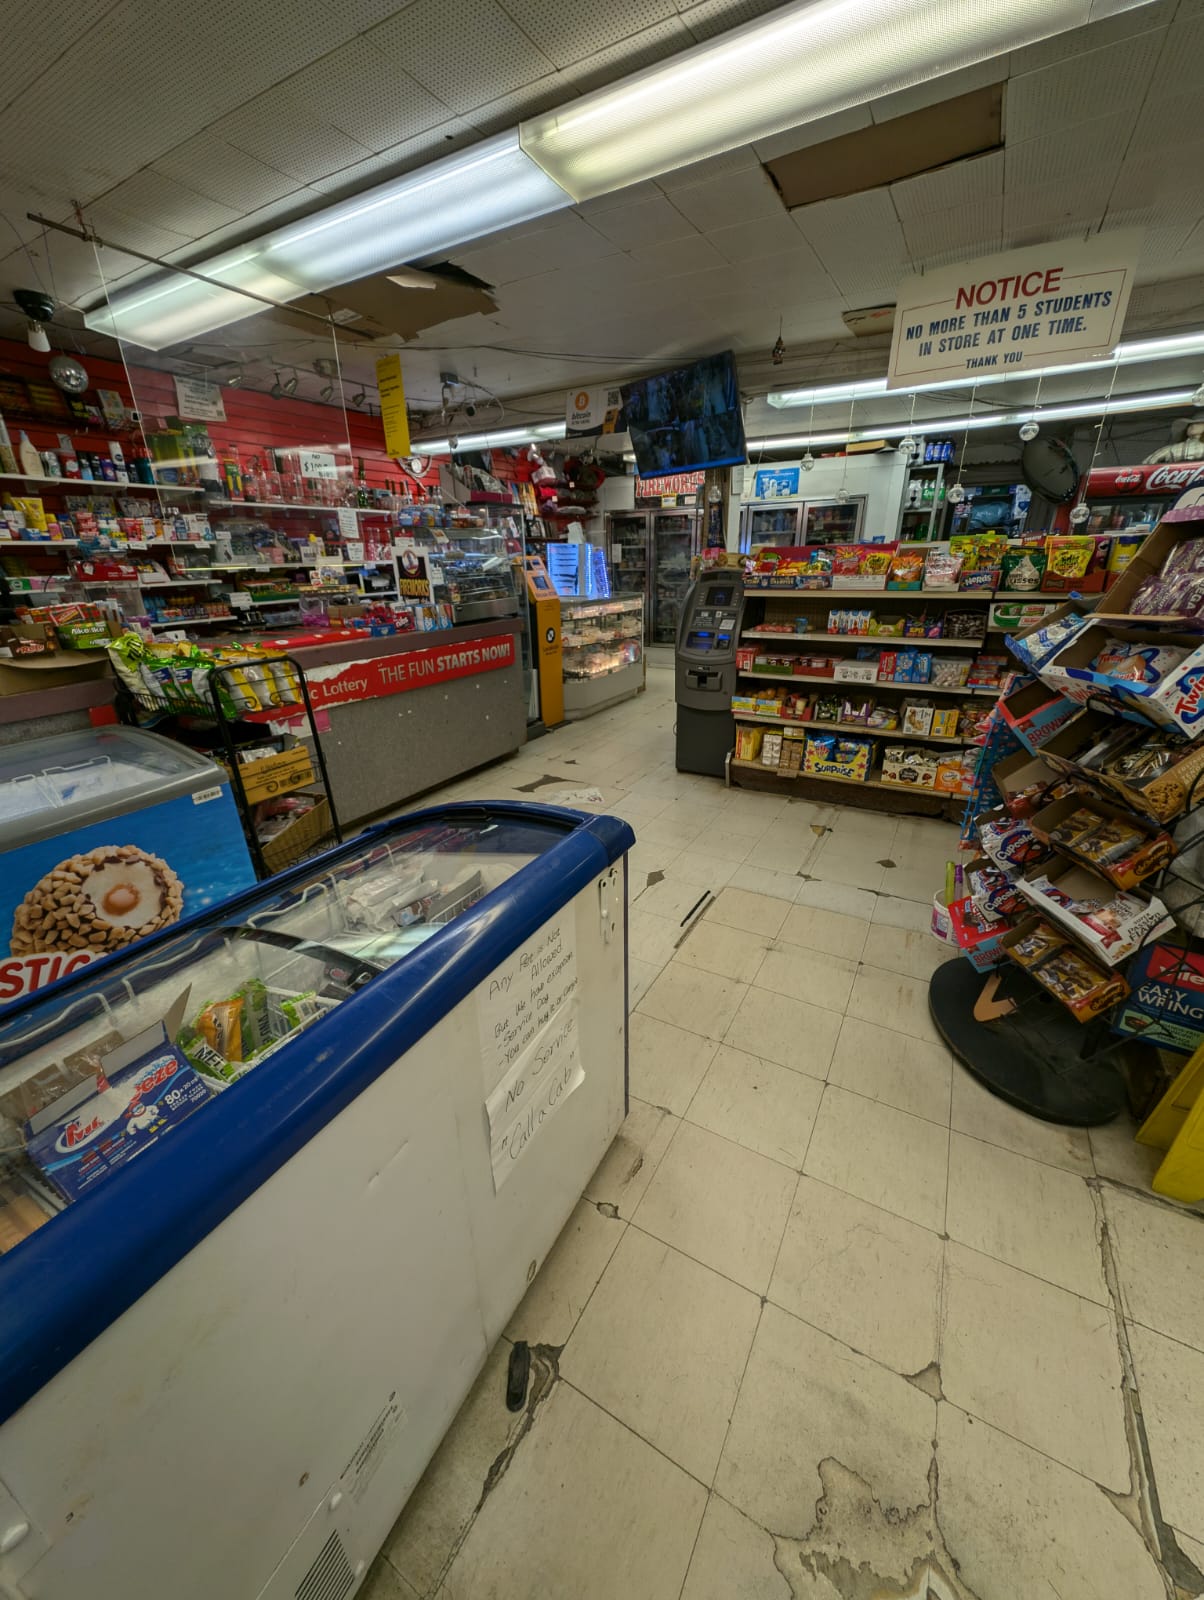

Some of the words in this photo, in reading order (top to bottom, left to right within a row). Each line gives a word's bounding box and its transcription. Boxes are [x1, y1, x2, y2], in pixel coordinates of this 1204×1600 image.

[955, 267, 1064, 310] NOTICE
[906, 324, 923, 341] NO
[929, 315, 966, 337] MORE
[973, 306, 1011, 327] THAN
[1017, 304, 1028, 320] 5
[1035, 290, 1114, 316] STUDENTS
[919, 341, 932, 357] IN
[938, 331, 981, 353] STORE
[987, 328, 1006, 345] AT
[1011, 322, 1041, 341] ONE
[1048, 316, 1088, 336] TIME.
[966, 356, 998, 369] THANK
[1003, 351, 1024, 364] YOU
[399, 578, 430, 597] FIREWORKS
[378, 666, 406, 685] THE
[408, 662, 435, 677] FUN
[437, 649, 481, 673] STARTS
[481, 643, 511, 661] NOW!
[322, 679, 368, 698] Lottery
[531, 937, 563, 980] Allowed
[489, 972, 514, 1000] Any
[1139, 982, 1188, 1002] EASY
[1138, 991, 1204, 1019] WRING
[494, 1018, 509, 1038] But
[522, 1027, 535, 1044] can
[505, 1080, 525, 1113] No
[532, 1018, 574, 1075] Service
[164, 1089, 181, 1104] 80
[538, 1110, 548, 1124] a
